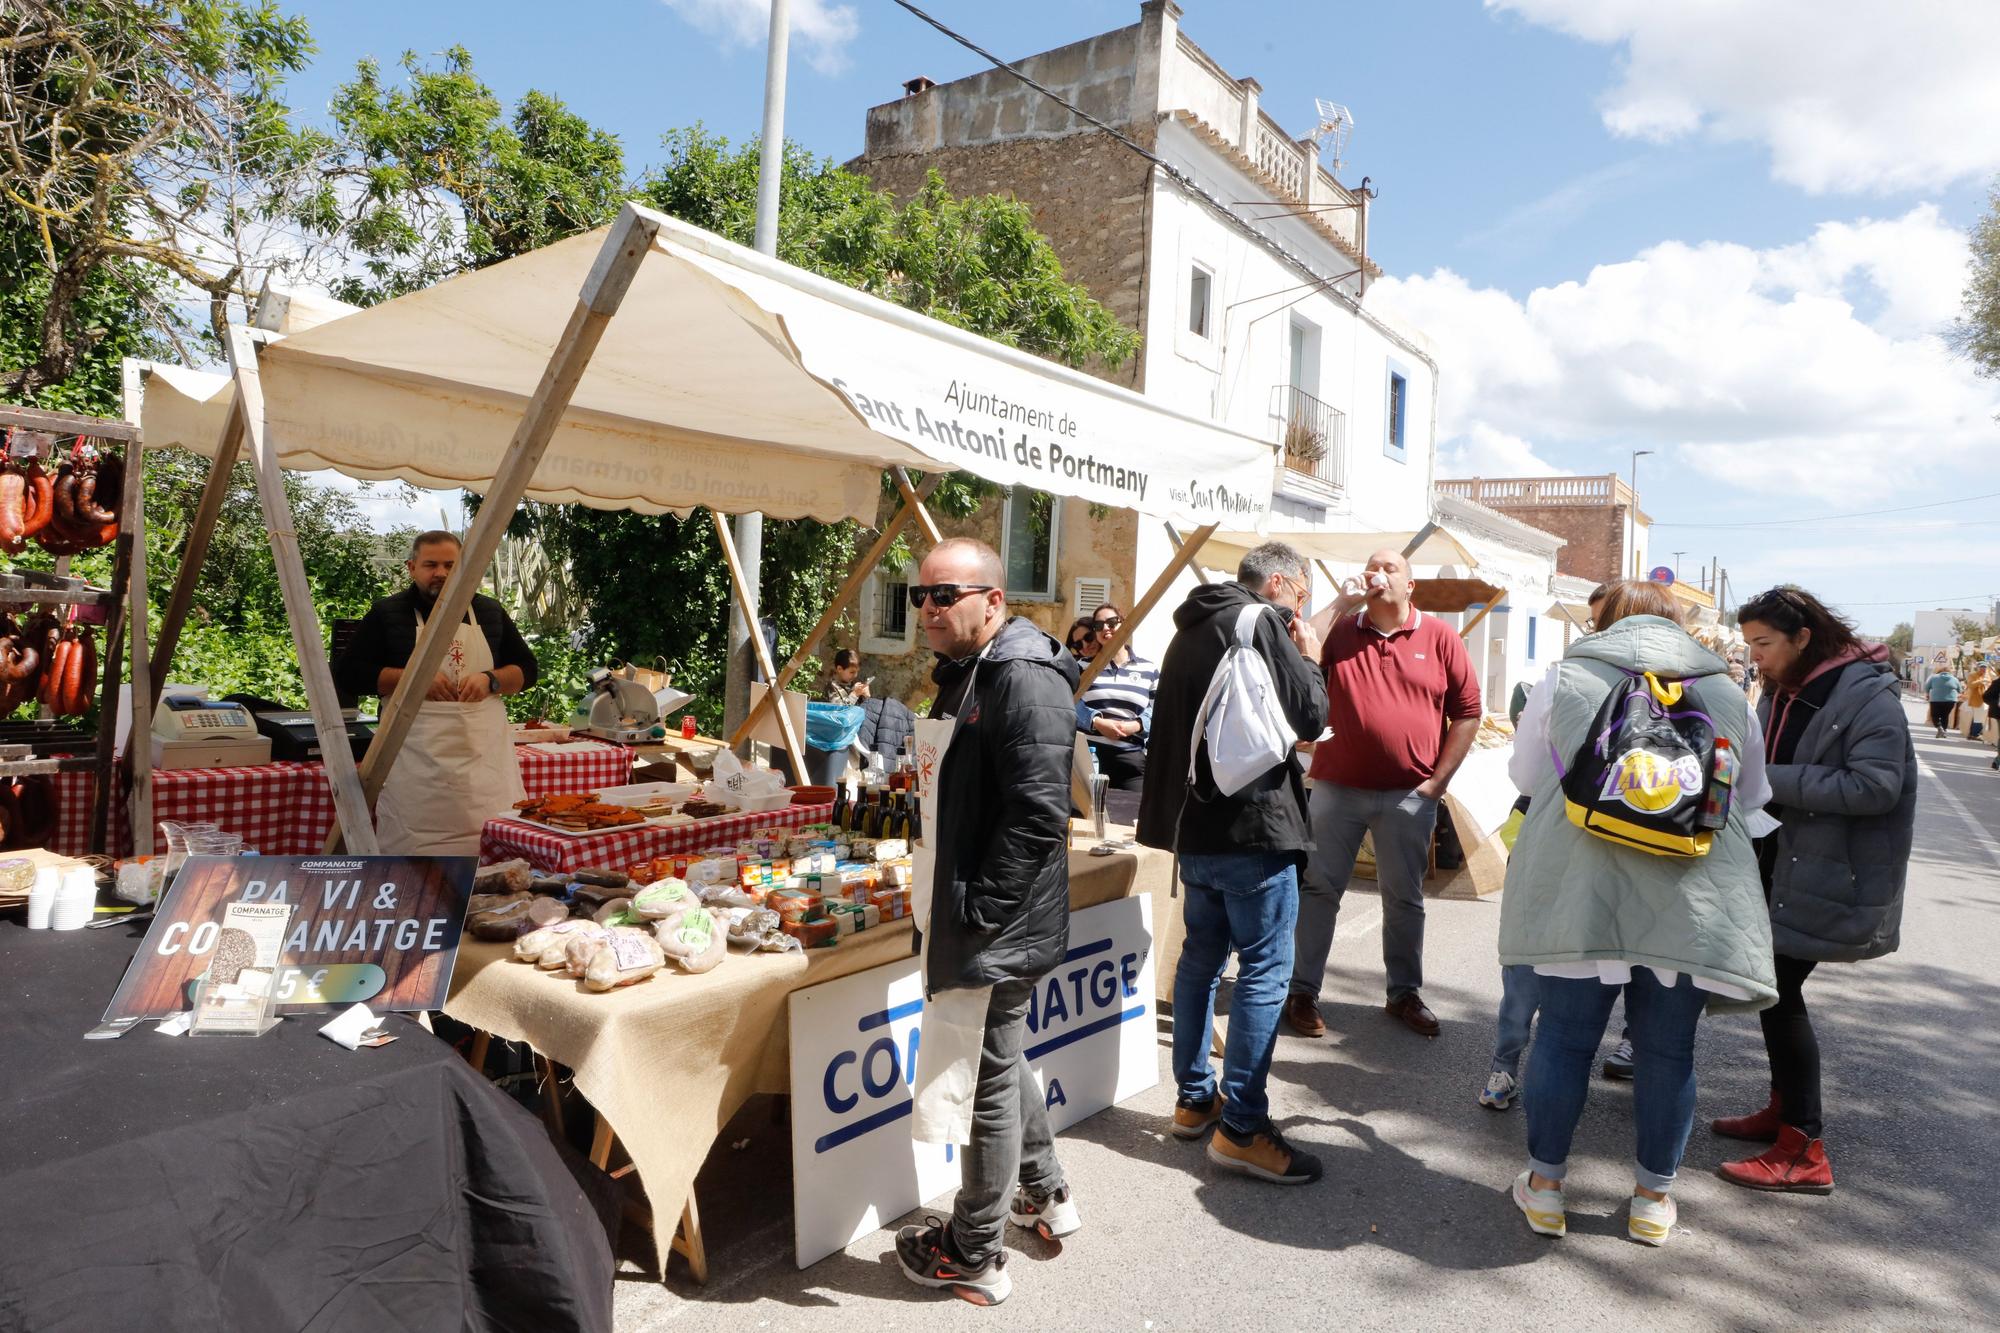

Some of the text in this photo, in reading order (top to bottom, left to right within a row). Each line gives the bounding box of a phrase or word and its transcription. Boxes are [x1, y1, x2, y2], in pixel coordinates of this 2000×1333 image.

[944, 379, 1077, 438] Ajuntament de
[914, 407, 1007, 463] Antoni
[1013, 435, 1043, 470] de
[1048, 443, 1149, 502] Portmany
[231, 906, 286, 916] COMPANATGE
[322, 880, 362, 910] VI
[373, 882, 399, 909] &
[157, 917, 447, 956] COANATGE
